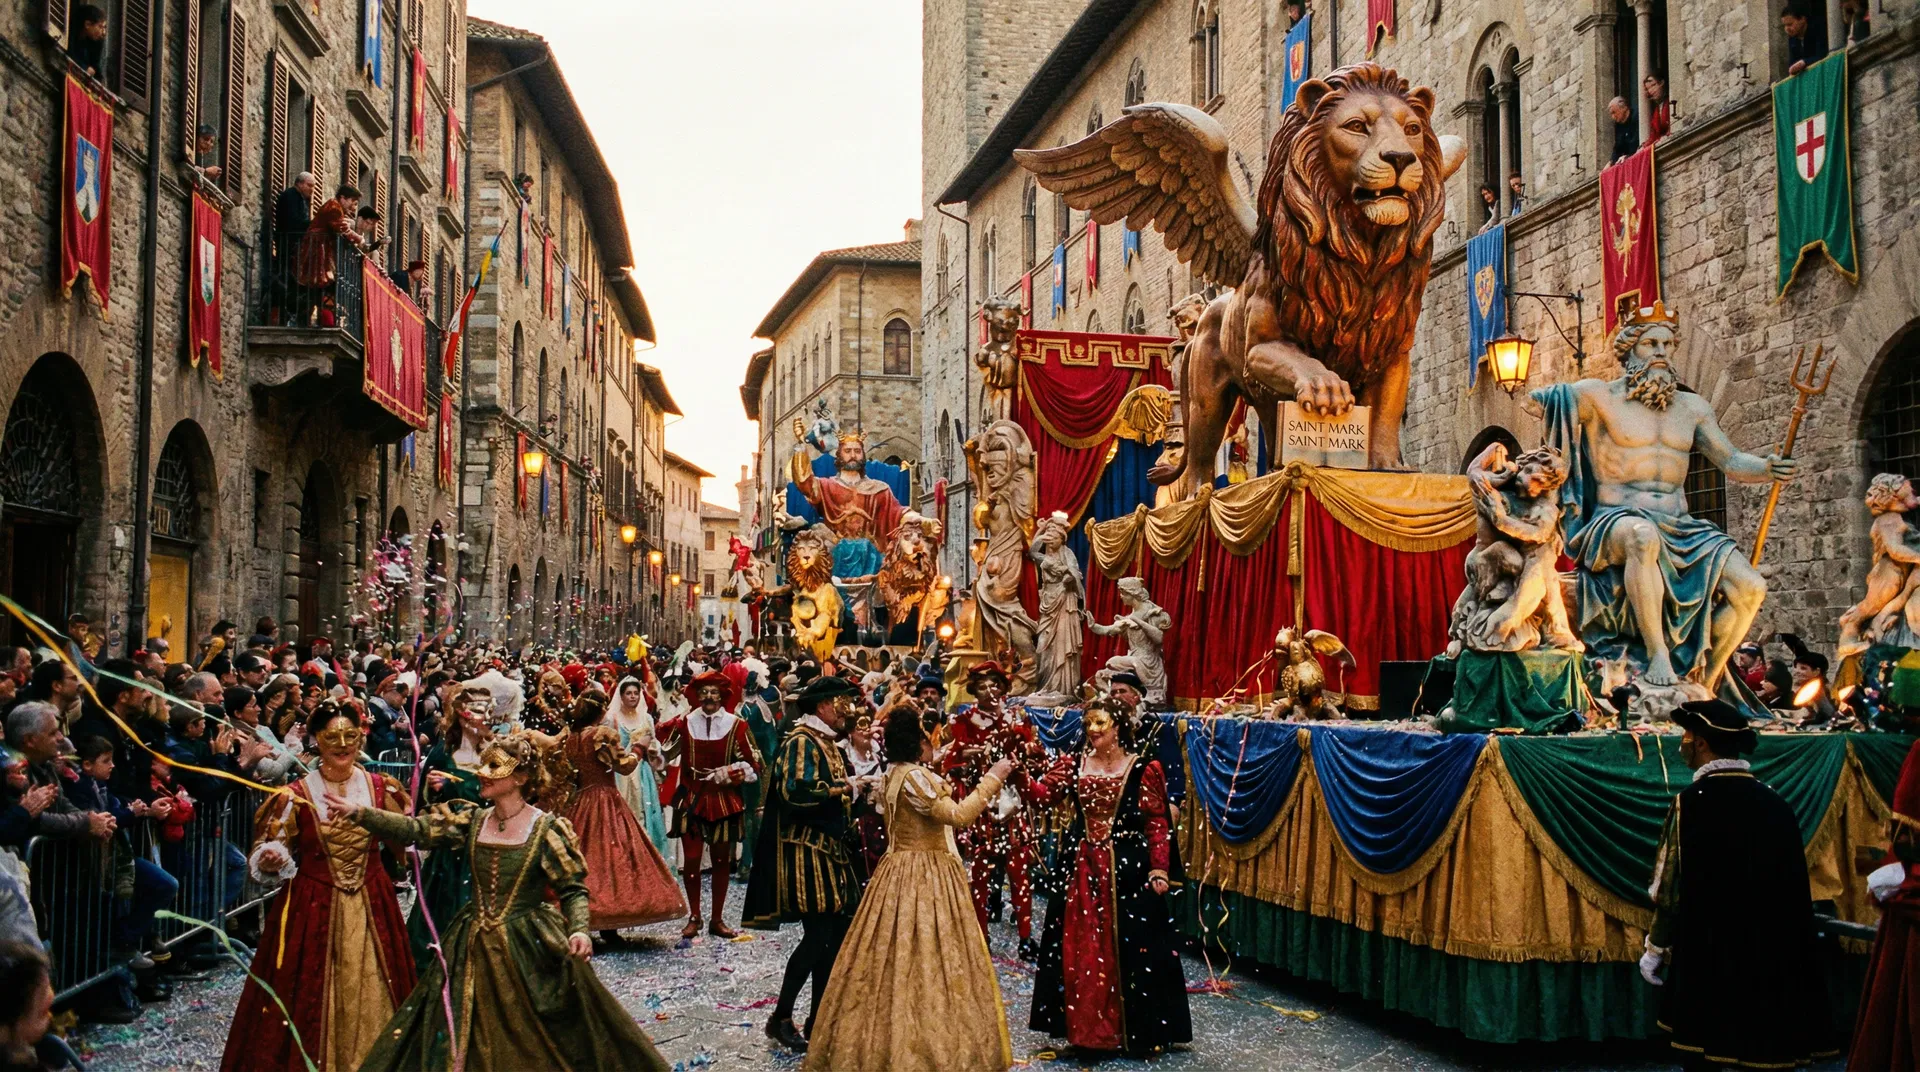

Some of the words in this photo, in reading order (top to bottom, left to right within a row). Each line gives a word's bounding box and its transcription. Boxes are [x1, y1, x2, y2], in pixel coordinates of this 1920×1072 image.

[1288, 420, 1325, 432] SAINT
[1328, 423, 1365, 435] MARK
[1288, 435, 1325, 447] SAINT
[1328, 438, 1365, 450] MARK
